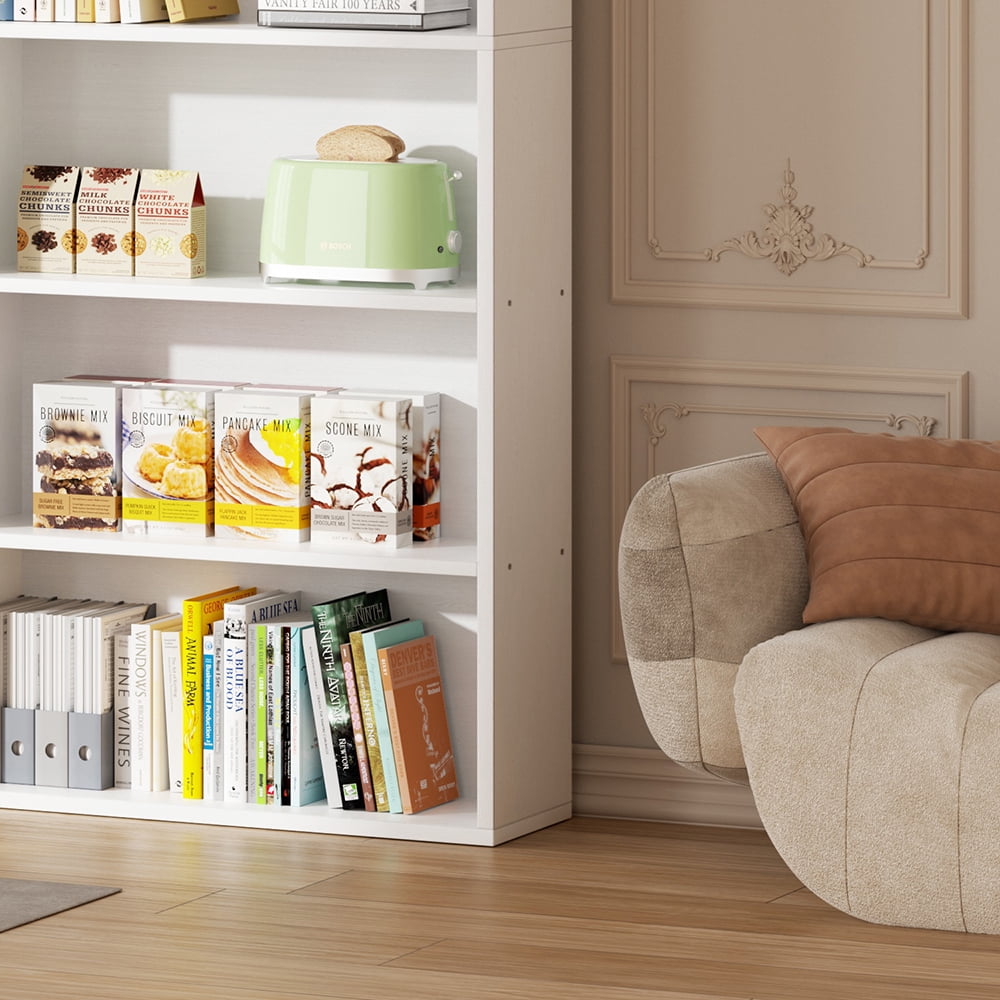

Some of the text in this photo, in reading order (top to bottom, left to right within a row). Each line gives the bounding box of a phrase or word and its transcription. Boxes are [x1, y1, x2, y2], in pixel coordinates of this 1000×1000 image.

[19, 196, 71, 204] CHOCOLATE
[20, 190, 72, 198] SEMISWEET
[79, 198, 130, 206] CHOCOLATE
[80, 191, 108, 199] MILK
[19, 202, 70, 212] CHUNKS
[78, 205, 130, 214] CHUNKS
[137, 207, 189, 216] CHUNKS
[40, 407, 109, 424] BROWNIE MIX
[131, 411, 196, 428] BISCUIT MIX
[222, 416, 292, 433] PANCAKE MIX
[304, 423, 312, 442] MIX
[325, 421, 382, 438] SCONE MIX
[401, 435, 409, 455] MIX
[250, 609, 257, 623] A
[283, 598, 299, 615] SEA
[355, 602, 385, 628] NINTH
[316, 611, 328, 630] THE
[319, 629, 335, 672] NINTH
[134, 630, 147, 698] WINDOWS
[185, 636, 197, 707] ANIMAL FARM
[225, 648, 233, 711] OF BLOOD
[235, 647, 244, 713] A BLUE SEA
[205, 663, 213, 738] Business and Production
[327, 676, 343, 722] AVATAR
[117, 656, 130, 768] FINE WINES
[362, 699, 376, 747] INFERNO
[338, 738, 349, 770] NEWTON
